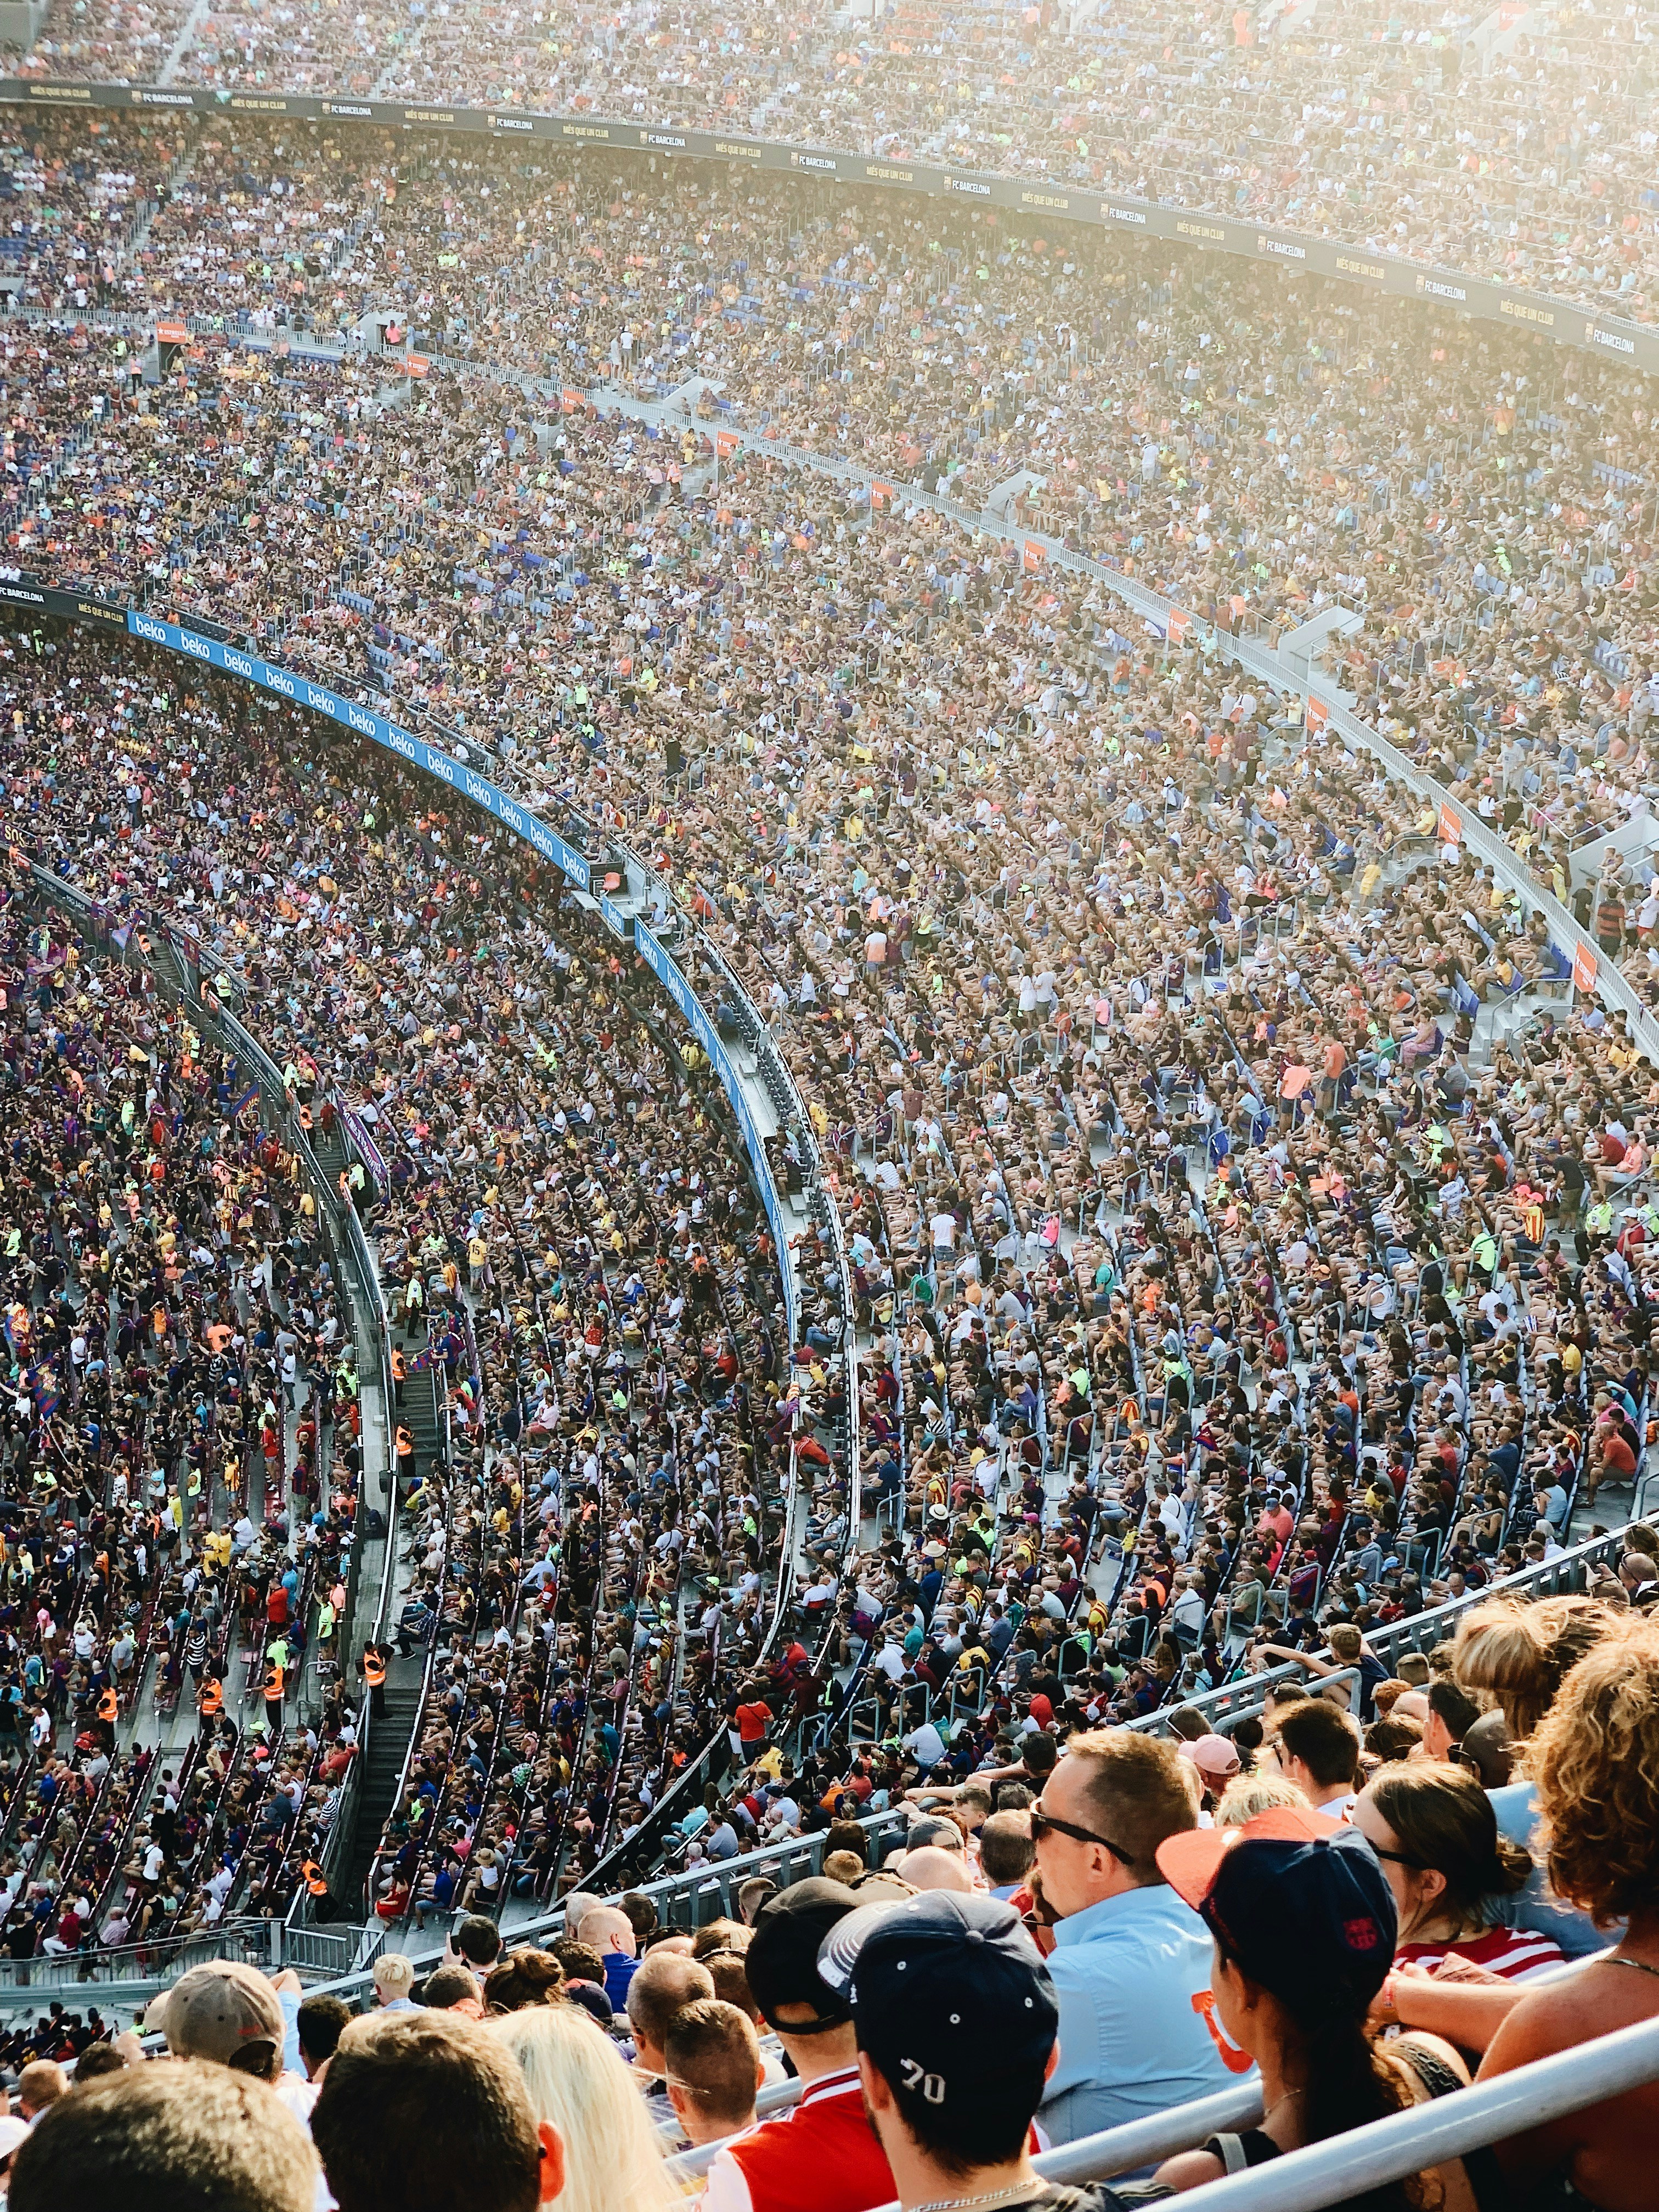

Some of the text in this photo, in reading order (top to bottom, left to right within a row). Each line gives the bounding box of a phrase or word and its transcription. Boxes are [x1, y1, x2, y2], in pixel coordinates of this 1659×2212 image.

[232, 98, 286, 110] MÉS QUE UN CLUB
[331, 105, 372, 116] FC BARCELONA
[405, 109, 454, 122] MÉS QUE UN CLUB
[497, 119, 533, 130] FC BARCELONA
[563, 125, 609, 138] MÉS QUE UN CLUB
[648, 134, 685, 146] FC BARCELONA
[716, 142, 761, 157] MÉS QUE UN CLUB
[799, 156, 836, 170] FC BARCELONA
[867, 166, 913, 182] MÉS QUE UN CLUB
[952, 180, 990, 195] FC BARCELONA
[1022, 192, 1068, 208] MÉS QUE UN CLUB
[1109, 208, 1146, 224] FC BARCELONA
[1177, 221, 1224, 240] MÉS QUE UN CLUB
[1267, 241, 1306, 259] FC BARCELONA
[1336, 256, 1384, 279] MÉS QUE UN CLUB
[1425, 280, 1466, 301] FC BARCELONA
[1500, 299, 1554, 326] MÉS QUE UN CLUB
[1594, 329, 1634, 354] FC BARCELONA
[8, 588, 44, 602] BARCELONA
[78, 603, 123, 623] MÉS QUE UN CLUB
[136, 616, 166, 641] beko
[181, 632, 210, 658] beko
[223, 649, 252, 676] beko
[266, 668, 294, 695] beko
[308, 686, 335, 714] beko
[349, 706, 376, 735] beko
[389, 727, 415, 758] beko
[427, 749, 454, 781] beko
[466, 772, 491, 806] beko
[499, 796, 522, 831] beko
[530, 821, 553, 856] beko
[562, 848, 585, 884] beko
[608, 904, 622, 929] beko
[639, 928, 658, 969] beko
[472, 1244, 480, 1255] 15
